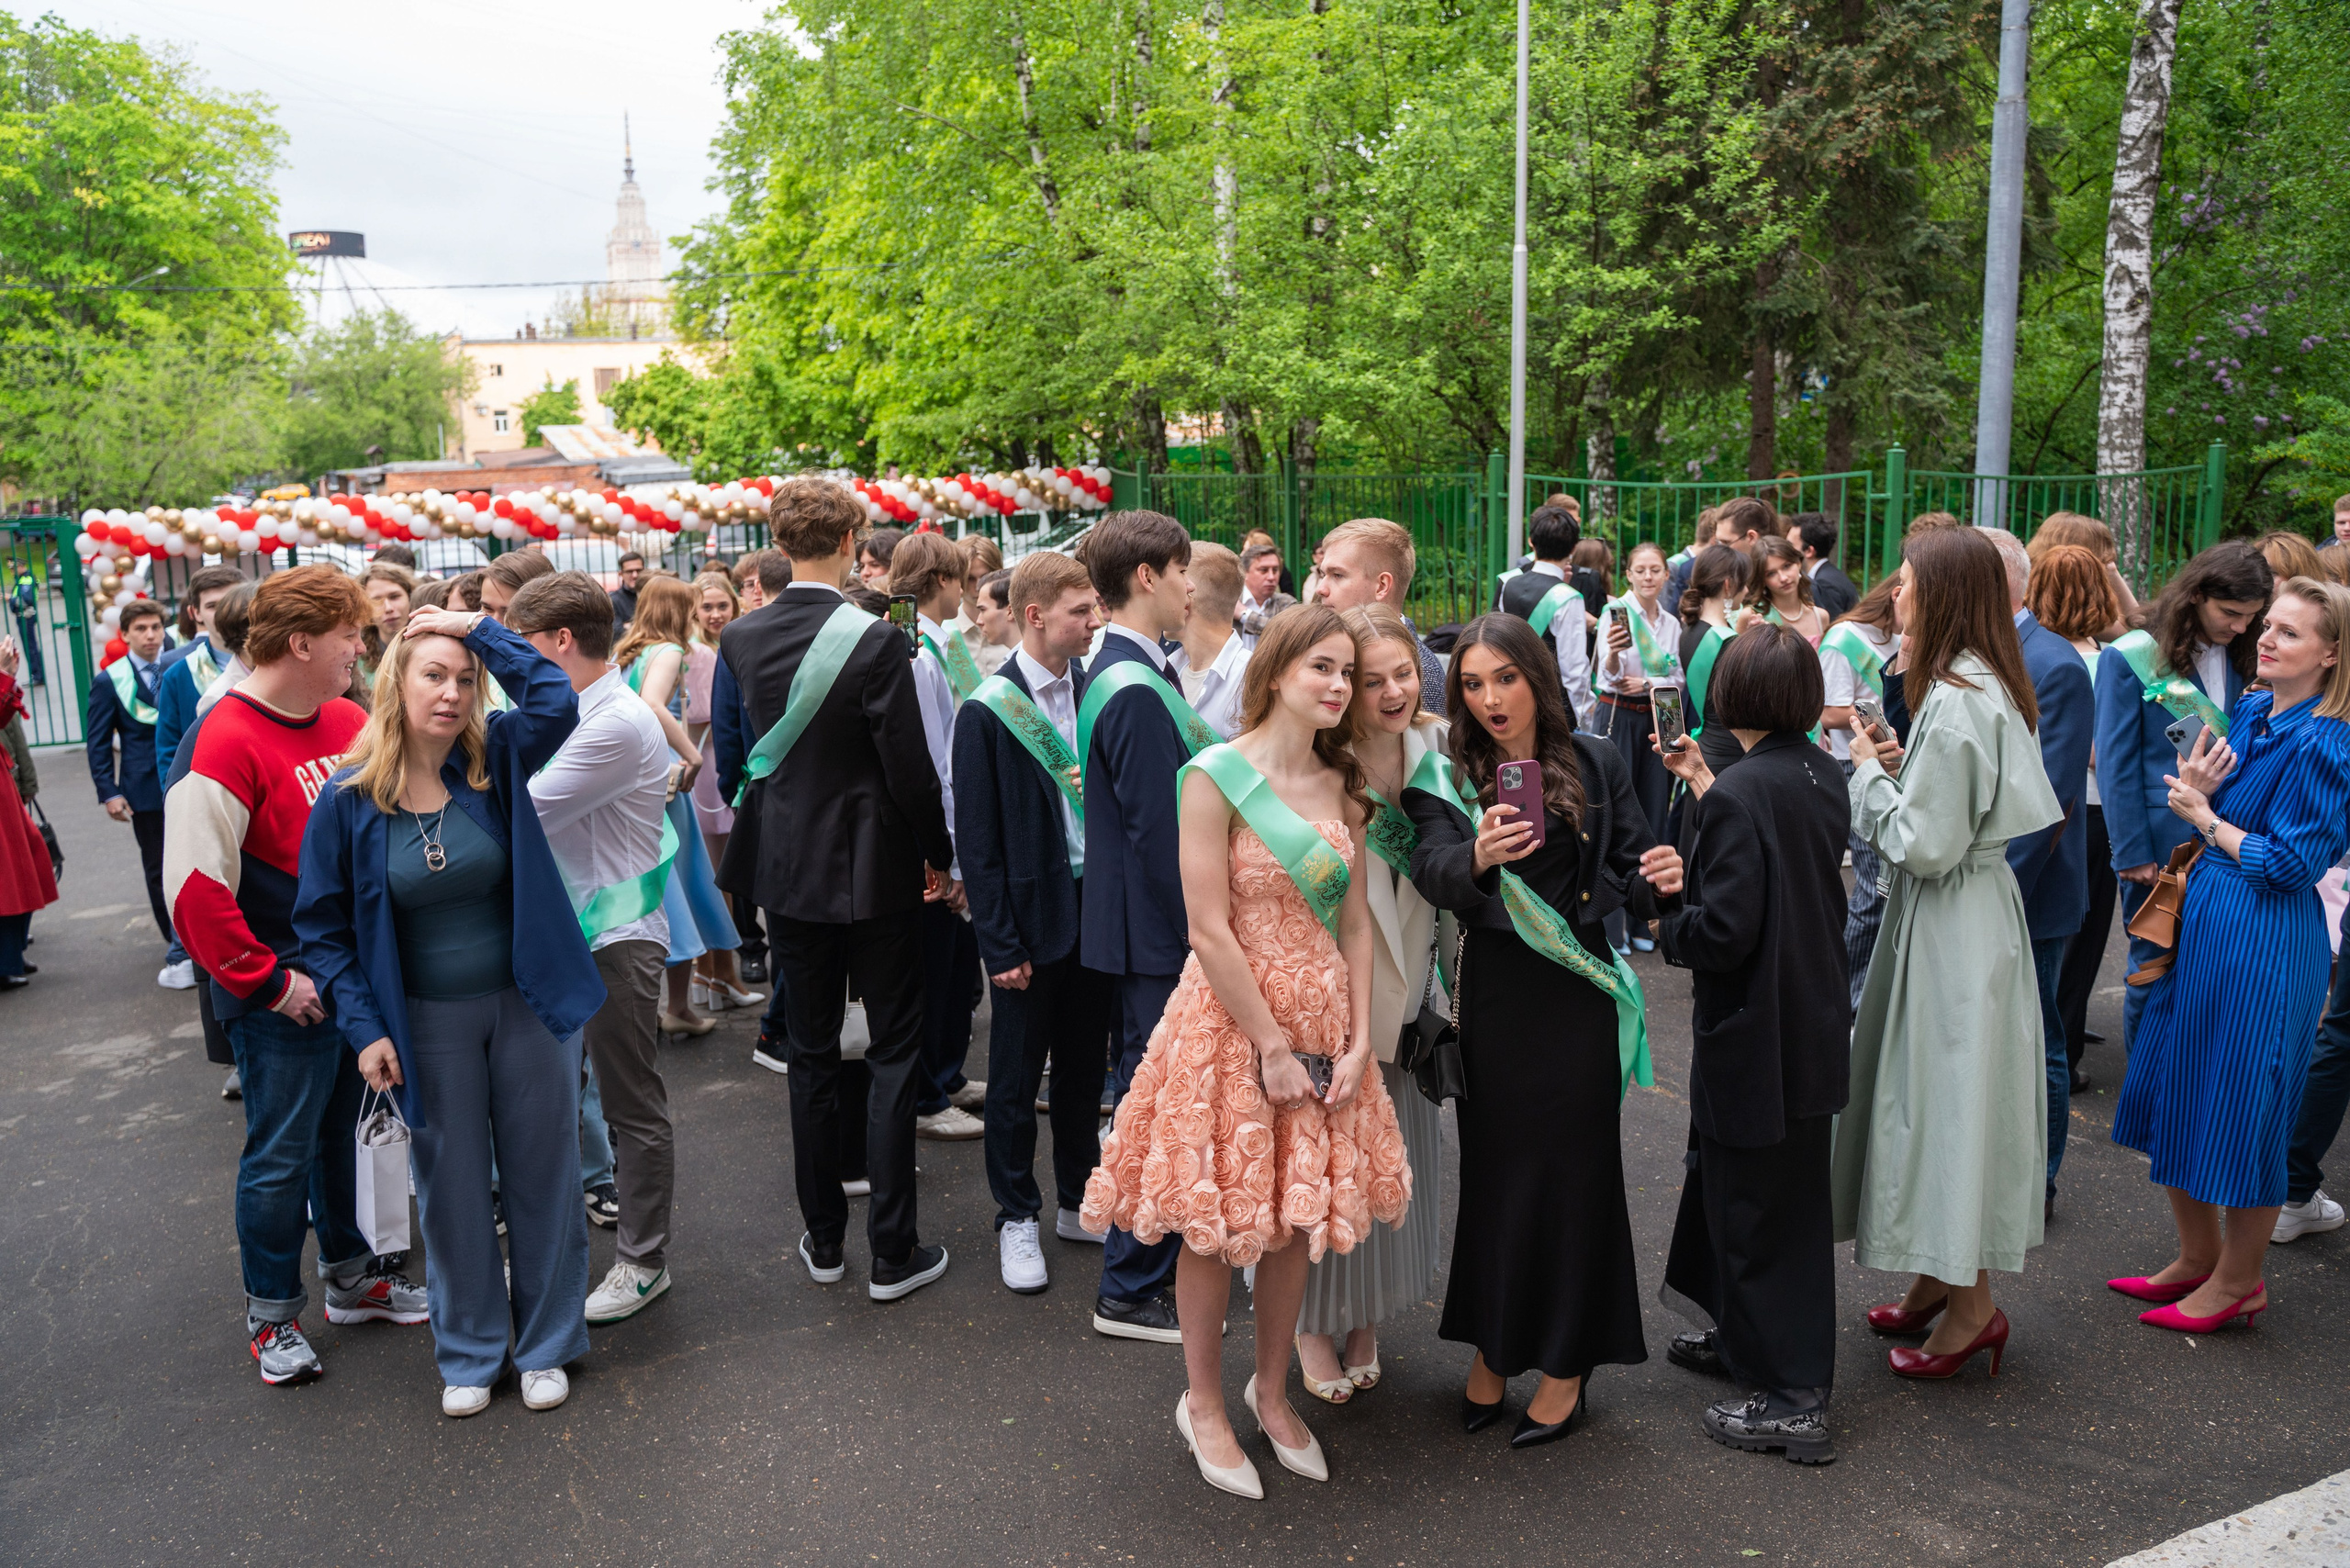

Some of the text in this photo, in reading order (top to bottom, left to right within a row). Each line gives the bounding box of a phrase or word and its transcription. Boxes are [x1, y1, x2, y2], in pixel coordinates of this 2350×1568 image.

[294, 754, 352, 808] GAN
[220, 958, 238, 970] GANT
[1558, 943, 1620, 991] 2025
